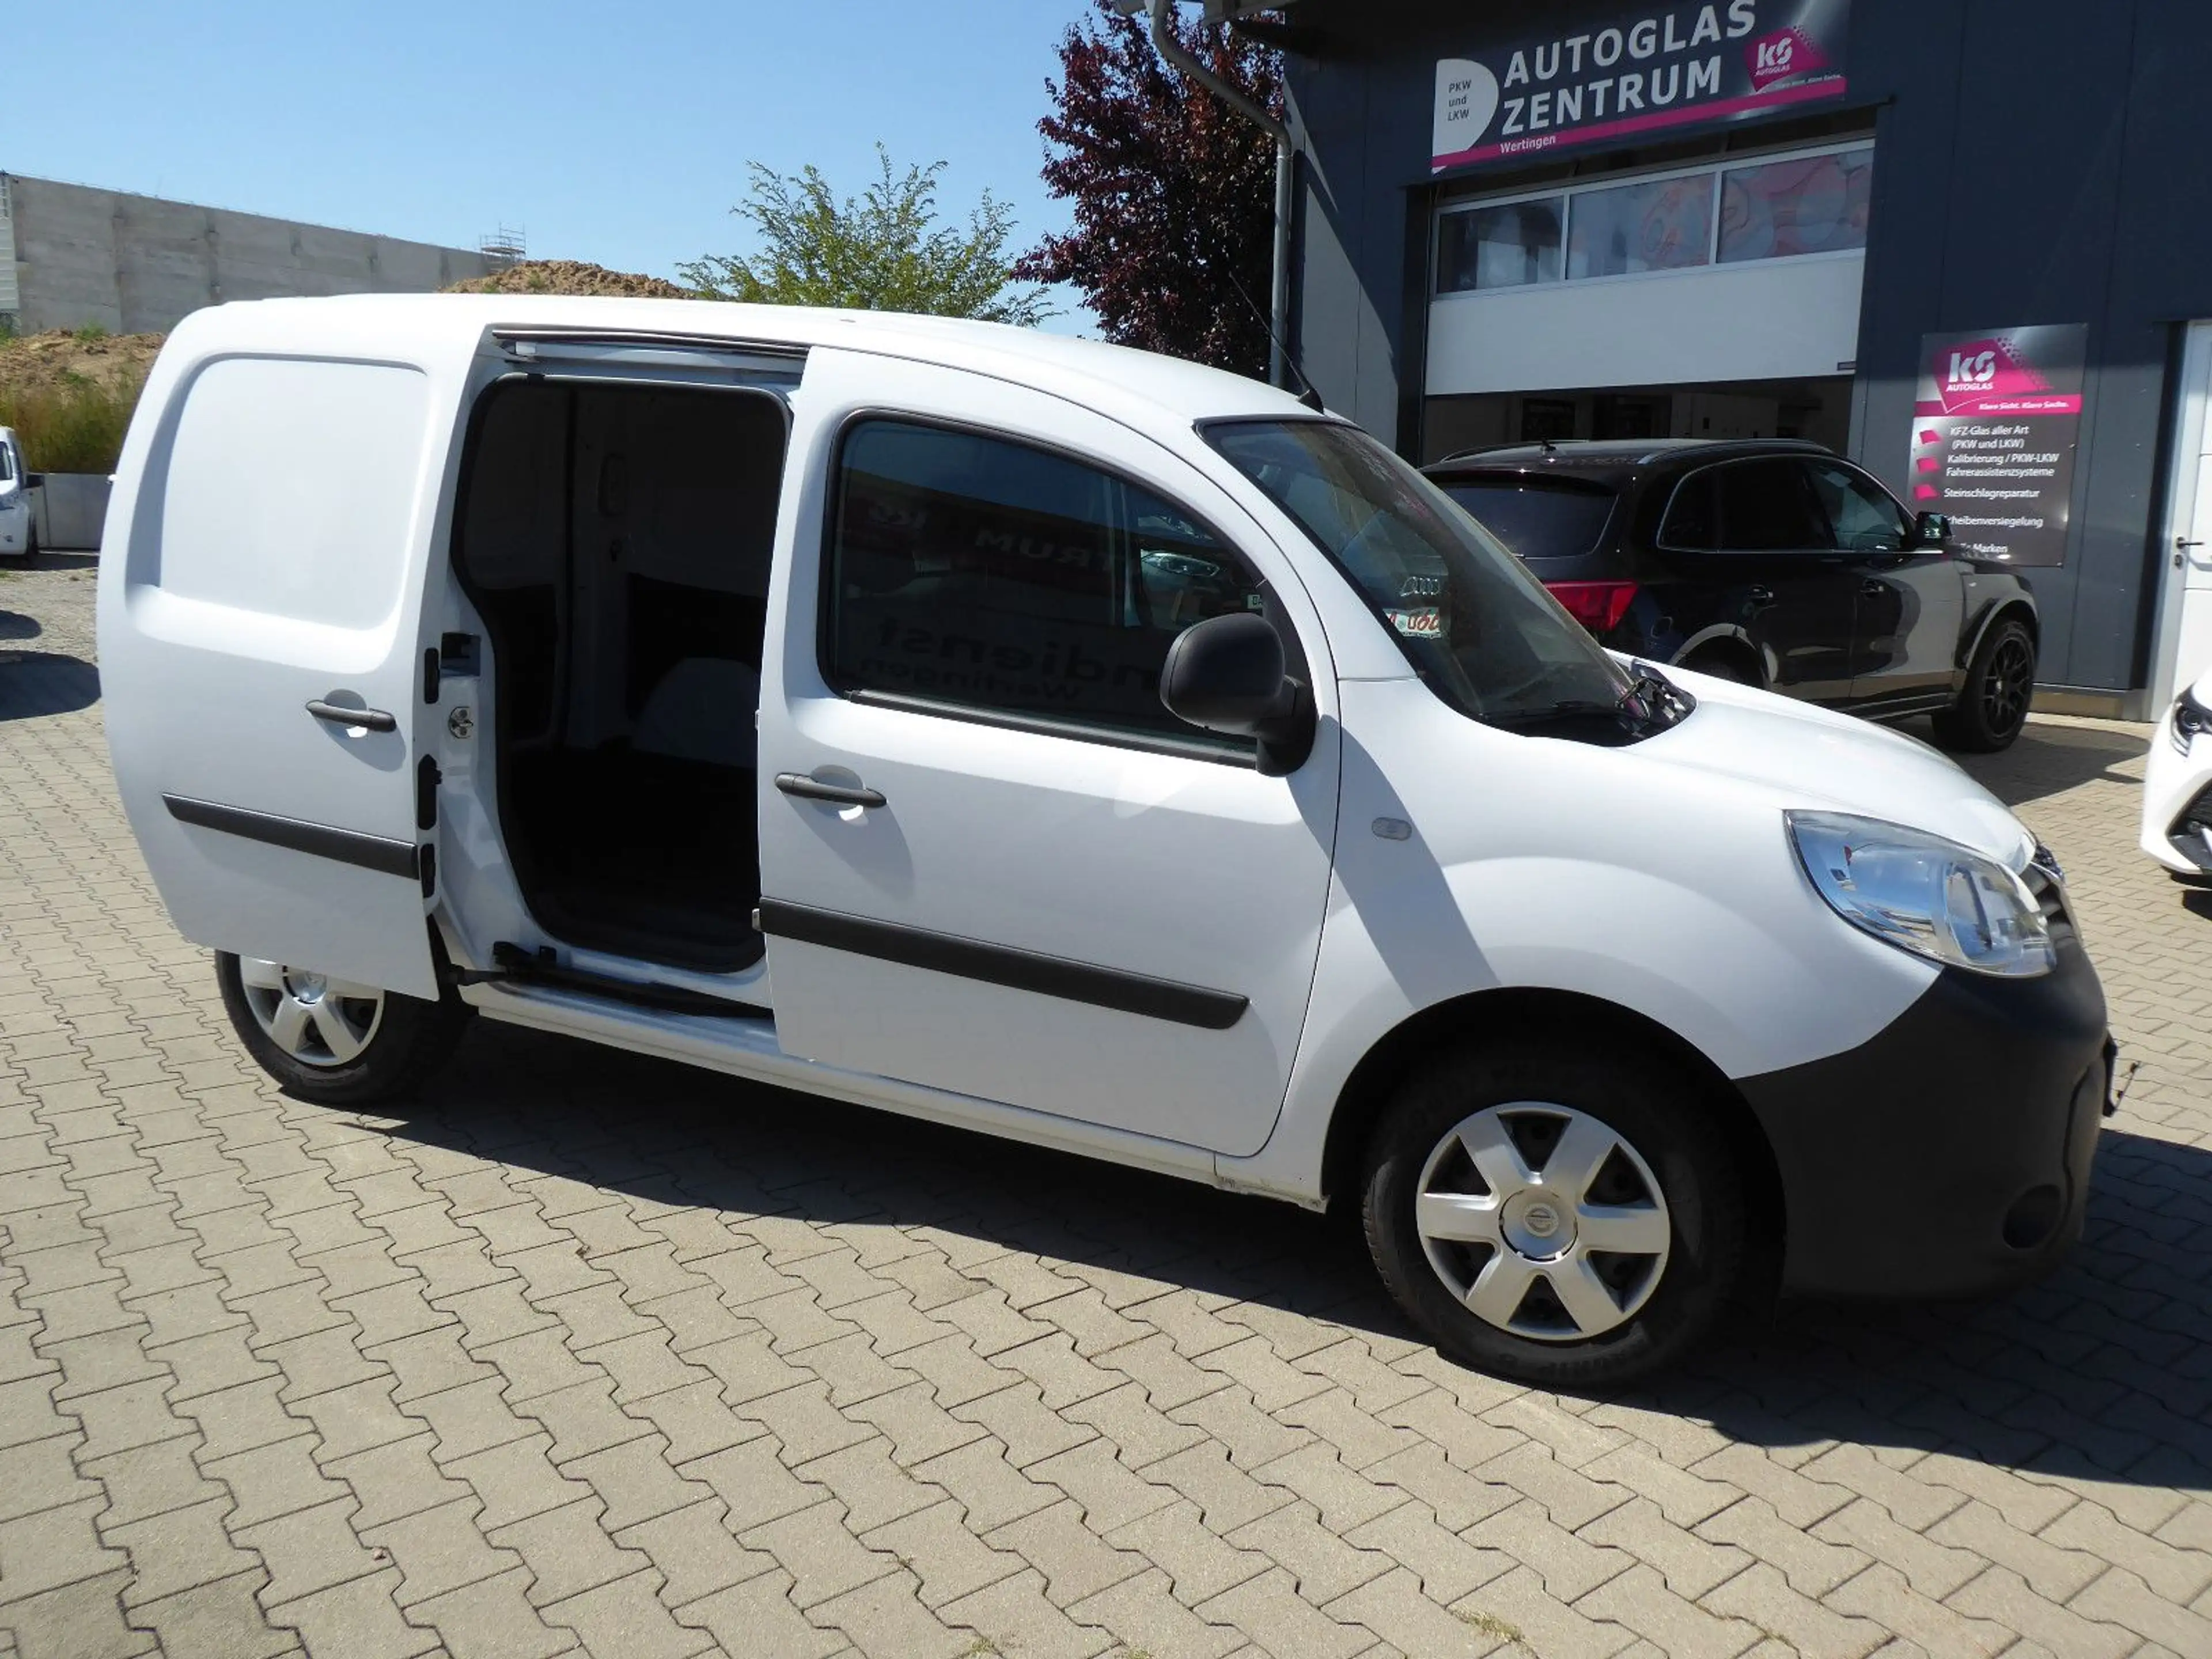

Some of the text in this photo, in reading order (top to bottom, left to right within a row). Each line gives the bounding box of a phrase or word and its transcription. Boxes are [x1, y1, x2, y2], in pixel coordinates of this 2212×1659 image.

[1504, 0, 1755, 88] AUTOGLAS
[1449, 79, 1471, 93] PKW
[1449, 96, 1467, 107] und
[1502, 56, 1721, 135] ZENTRUM
[1448, 109, 1469, 121] LKW
[1500, 135, 1556, 154] Wertingen
[1946, 382, 1994, 392] AUTOGLAS
[1991, 426, 2013, 434] aller
[2014, 425, 2030, 434] Art
[1952, 440, 1978, 450] (PKW
[1978, 439, 1997, 449] und
[1948, 454, 2004, 465] Kalibrierung
[2010, 453, 2060, 463] PKW-LKW
[1946, 467, 2055, 479] Fahrerassistenzsysteme
[1944, 488, 2040, 500] Steinschlagreparatur
